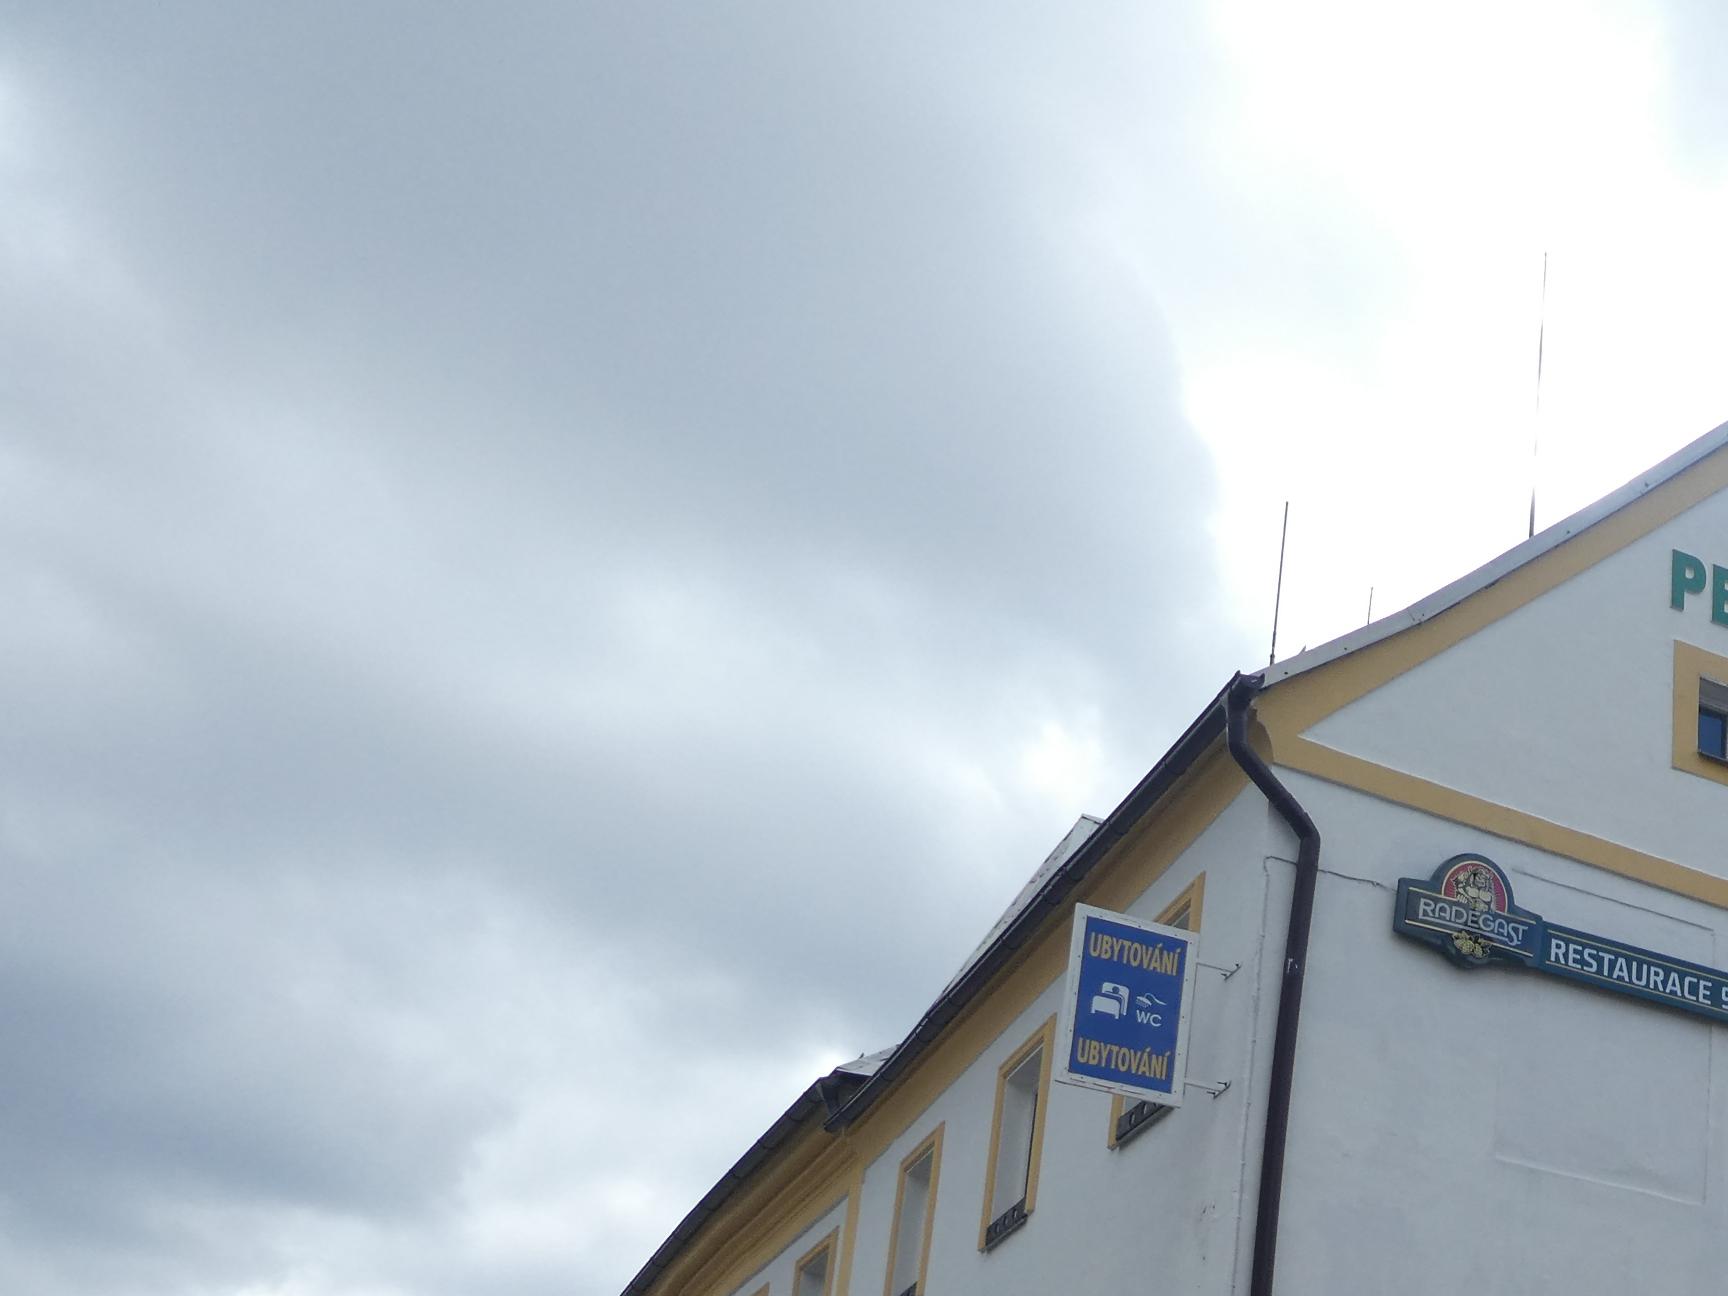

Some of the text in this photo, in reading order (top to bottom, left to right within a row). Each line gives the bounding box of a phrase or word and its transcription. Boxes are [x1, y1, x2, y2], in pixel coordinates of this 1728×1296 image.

[1418, 898, 1528, 945] RADEGAST
[1090, 932, 1181, 976] UBYTOVÁNÍ
[1550, 938, 1712, 1005] RESTAURACE
[1136, 1010, 1162, 1027] WC
[1077, 1037, 1171, 1080] UBYTOVÁNÍ
